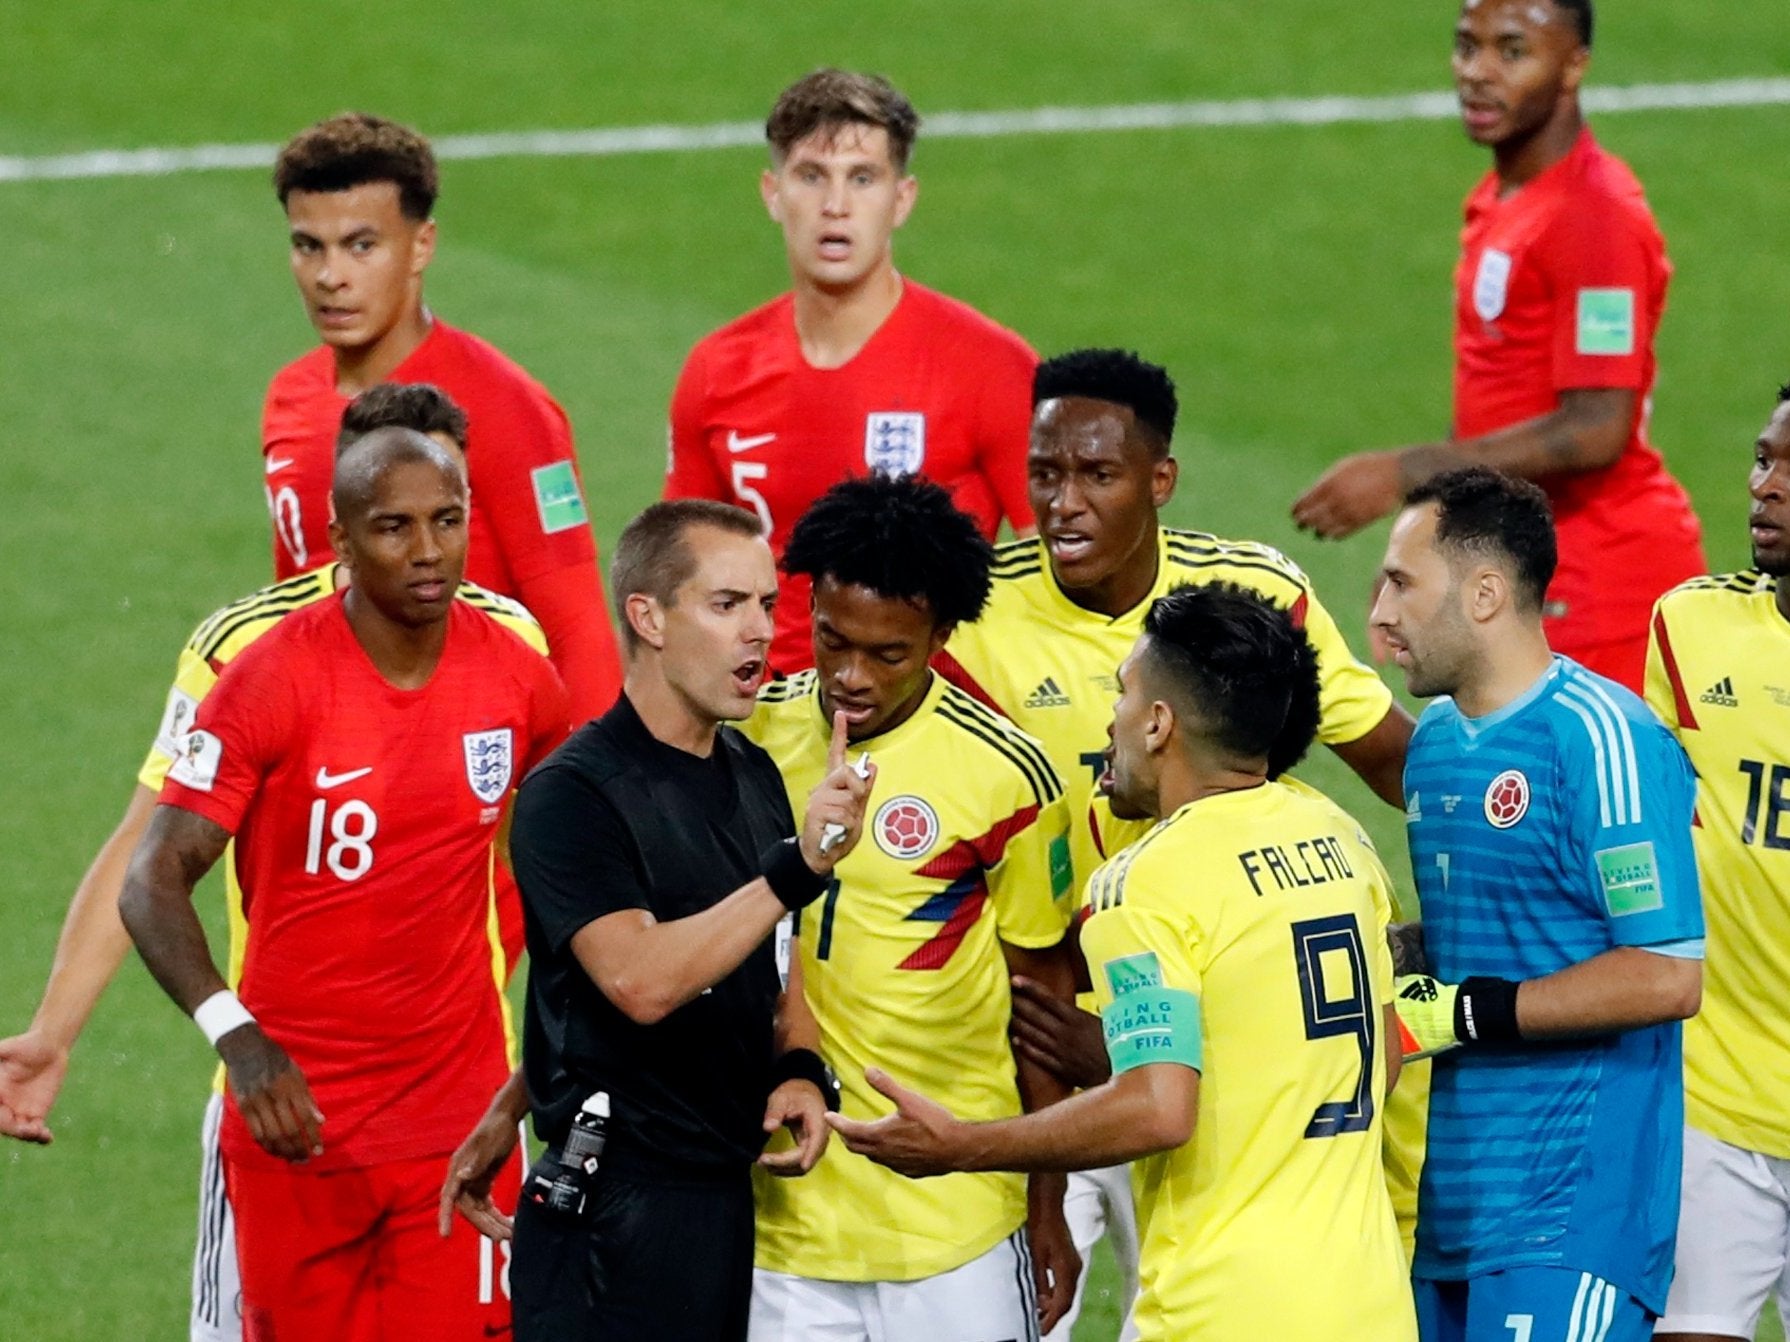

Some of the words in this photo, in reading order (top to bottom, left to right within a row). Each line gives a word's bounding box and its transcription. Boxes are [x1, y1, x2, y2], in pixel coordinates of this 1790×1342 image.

[731, 461, 775, 545] 5
[264, 484, 308, 568] 0
[1024, 696, 1071, 708] adidas
[1700, 694, 1738, 707] adidas
[305, 798, 378, 882] 18
[1238, 836, 1354, 897] FALCAO
[1106, 1014, 1172, 1038] OTBALL
[1108, 1001, 1172, 1024] VING
[1291, 912, 1374, 1140] 9
[1135, 1036, 1173, 1051] FIFA
